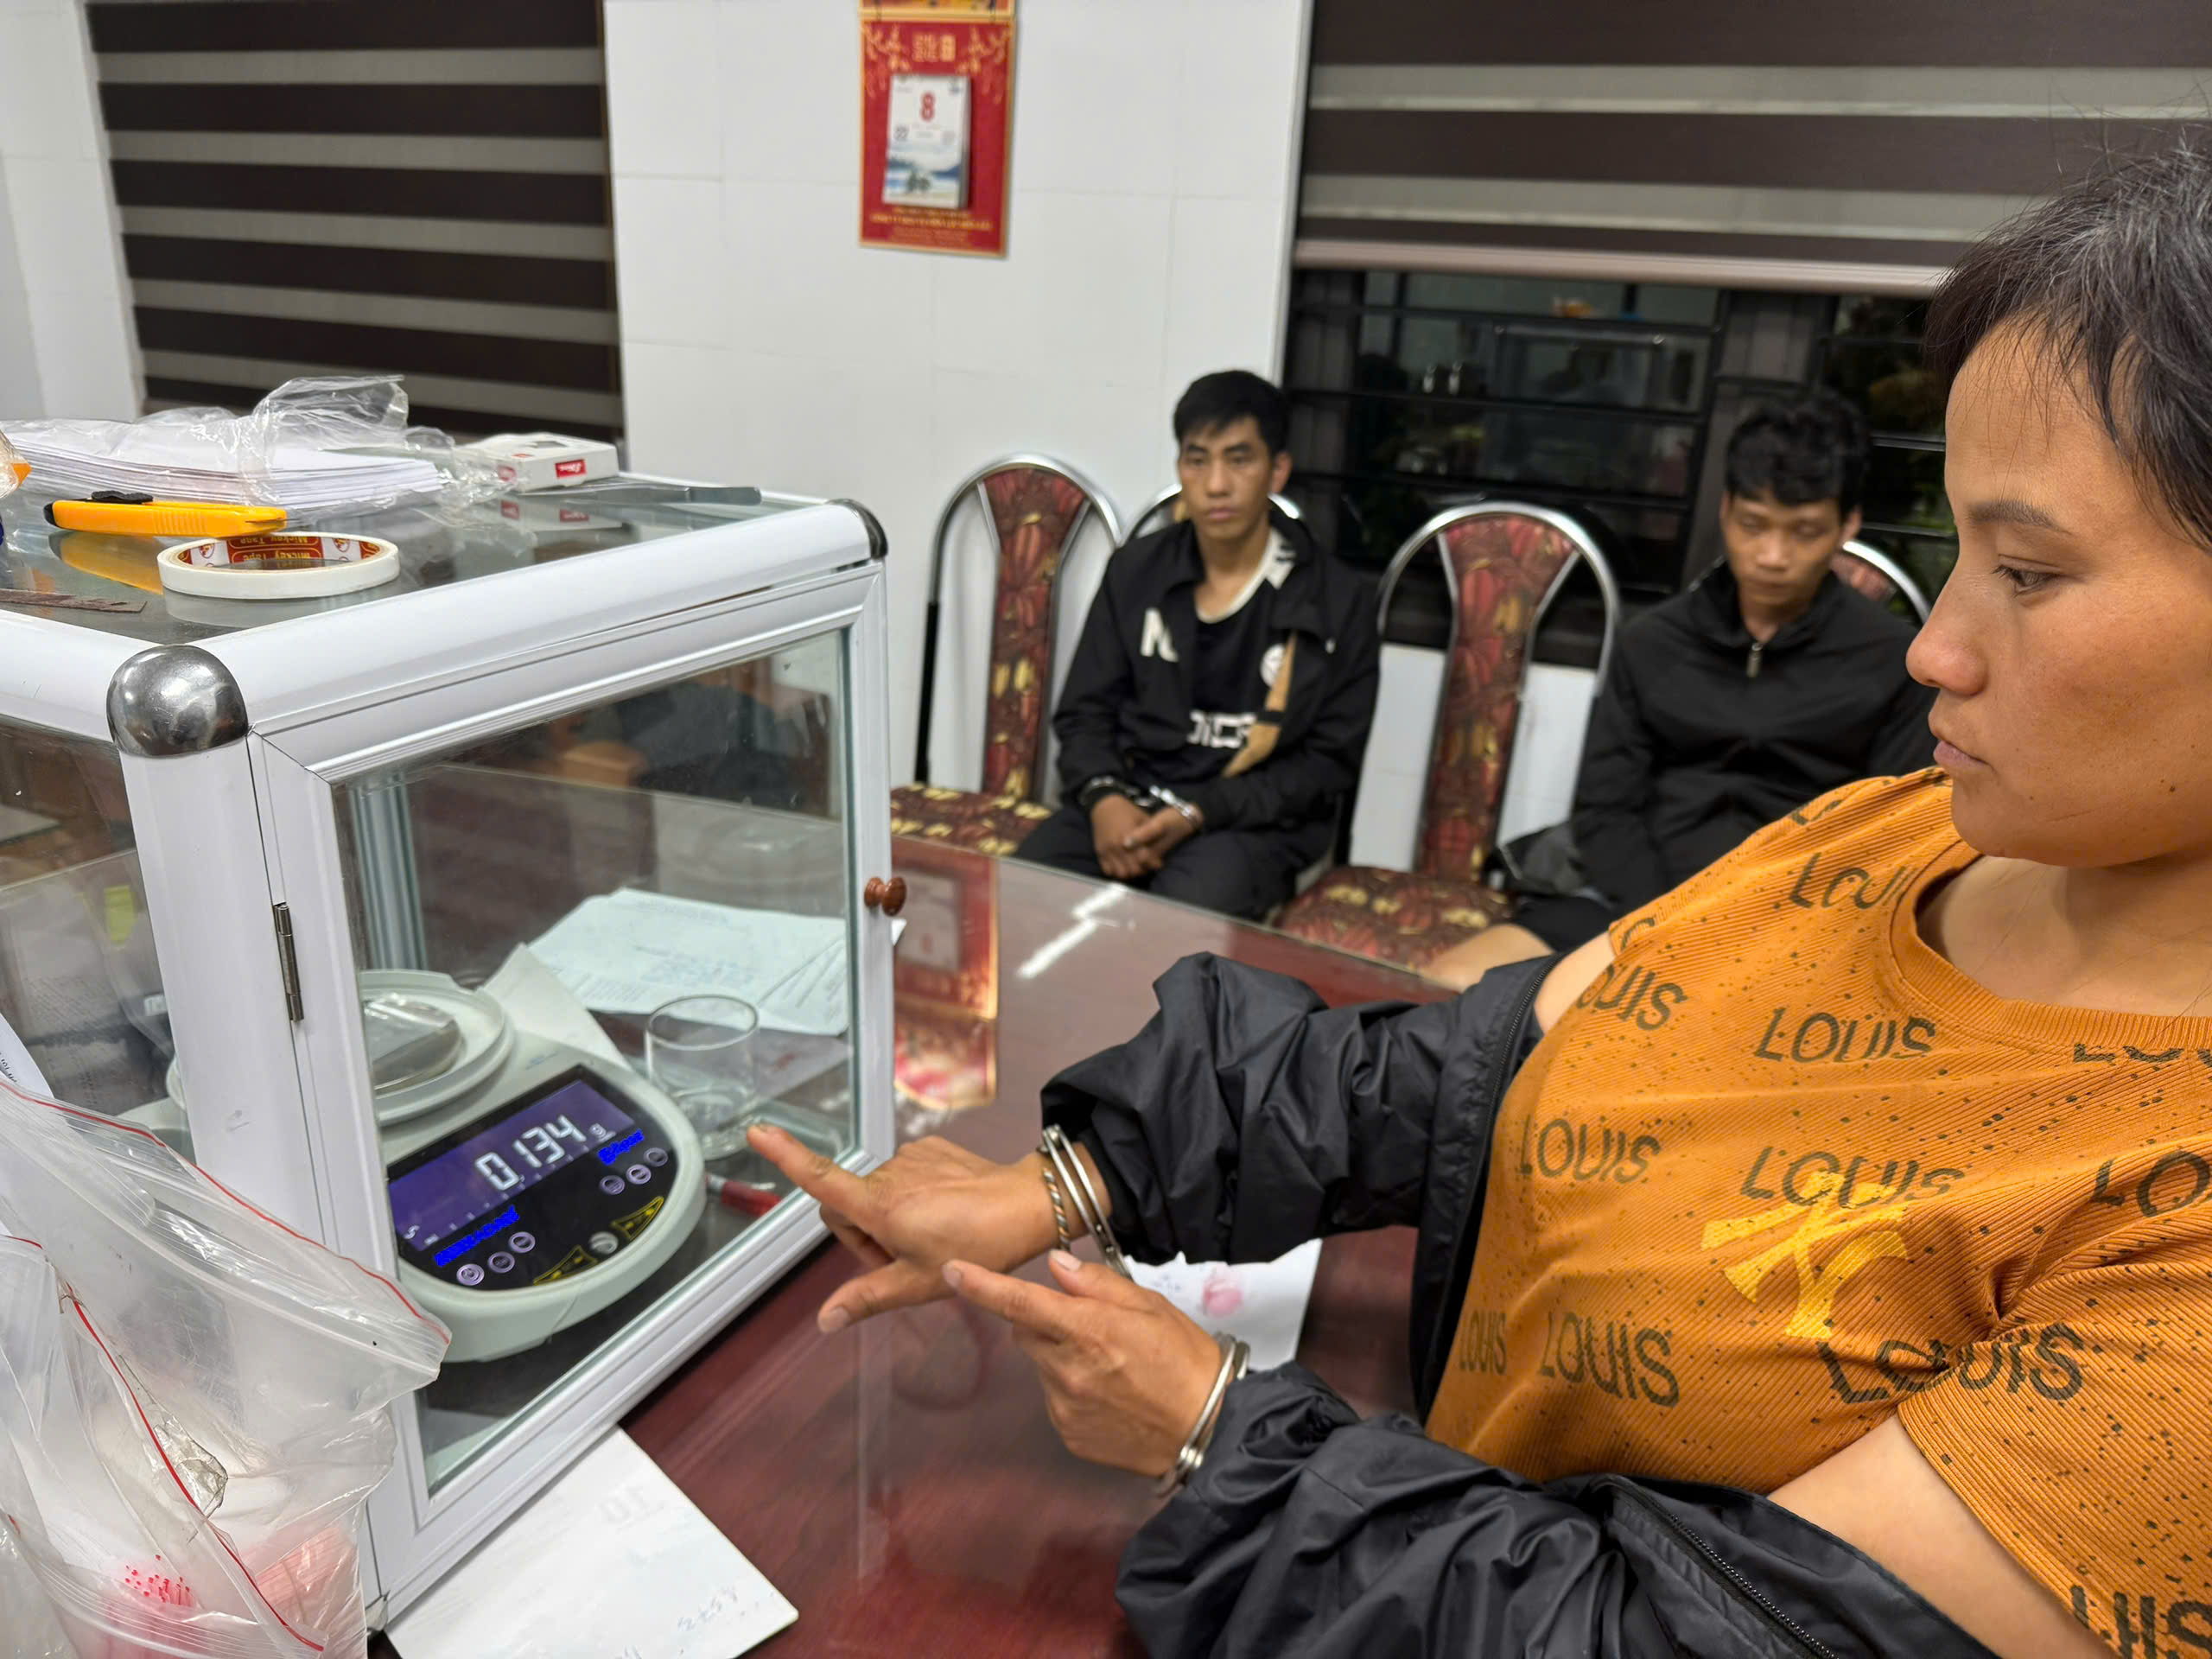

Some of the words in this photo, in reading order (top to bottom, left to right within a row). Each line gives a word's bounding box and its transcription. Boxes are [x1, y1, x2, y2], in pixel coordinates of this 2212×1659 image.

[1753, 1007, 1936, 1063] LOUIS
[1520, 1114, 1661, 1185] LOUIS
[1740, 1147, 1966, 1210] LOUIS
[1458, 1309, 1507, 1376] LOUIS
[1540, 1310, 1680, 1408] LOUIS
[1815, 1322, 2084, 1404] LOUIS
